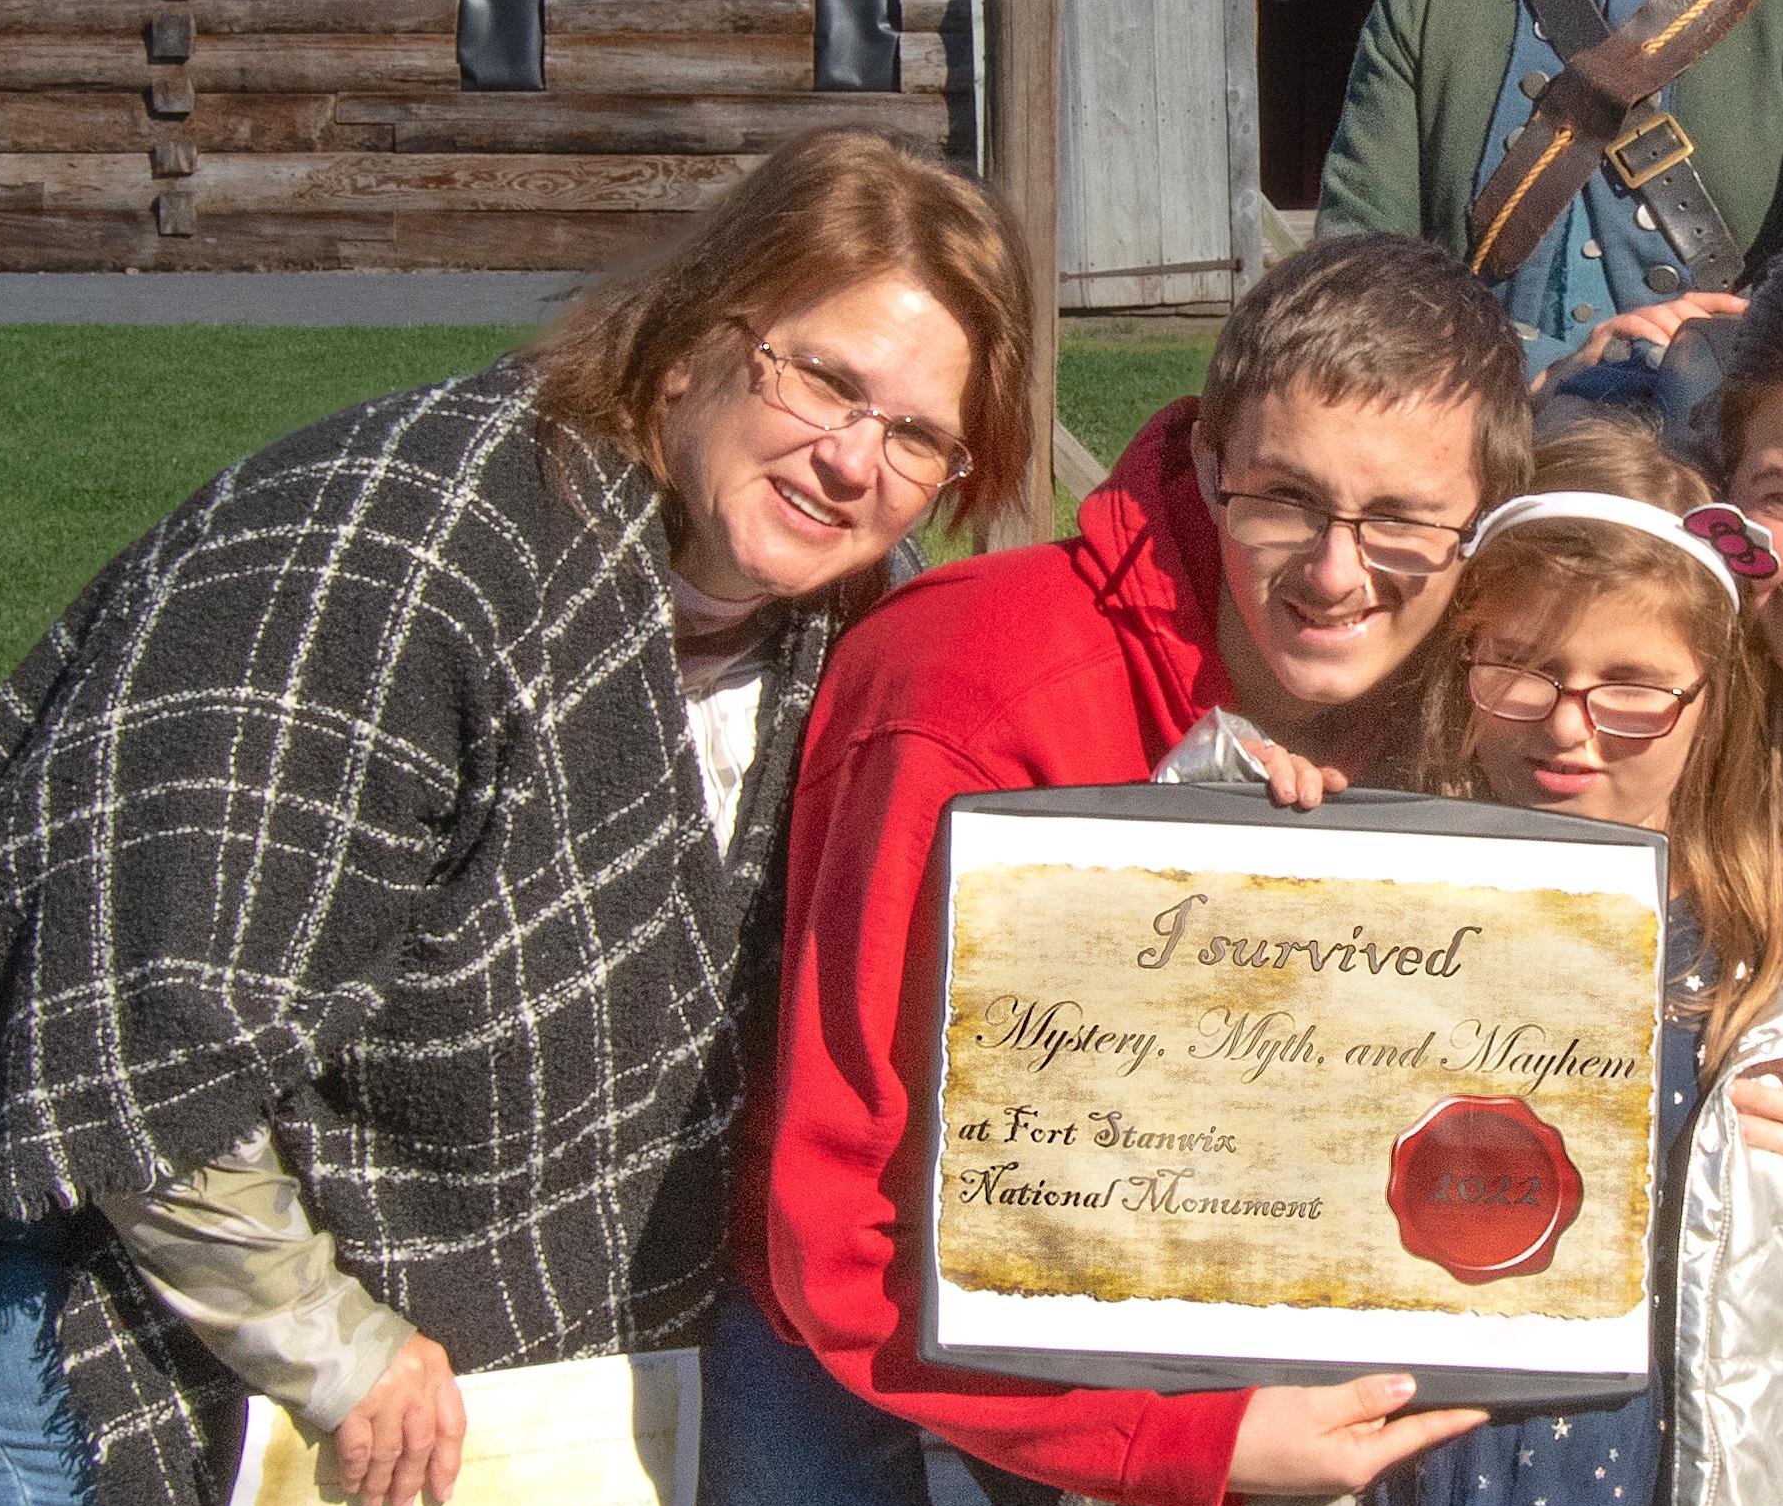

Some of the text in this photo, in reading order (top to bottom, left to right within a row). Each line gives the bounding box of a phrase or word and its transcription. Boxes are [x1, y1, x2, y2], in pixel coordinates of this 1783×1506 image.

[1137, 893, 1483, 978] I survived
[1345, 1031, 1437, 1069] and
[1439, 1019, 1637, 1095] Mayhem
[958, 1105, 1237, 1153] at Fort Stanwix
[960, 1161, 1323, 1219] National Monument
[1427, 1168, 1542, 1208] 2022
